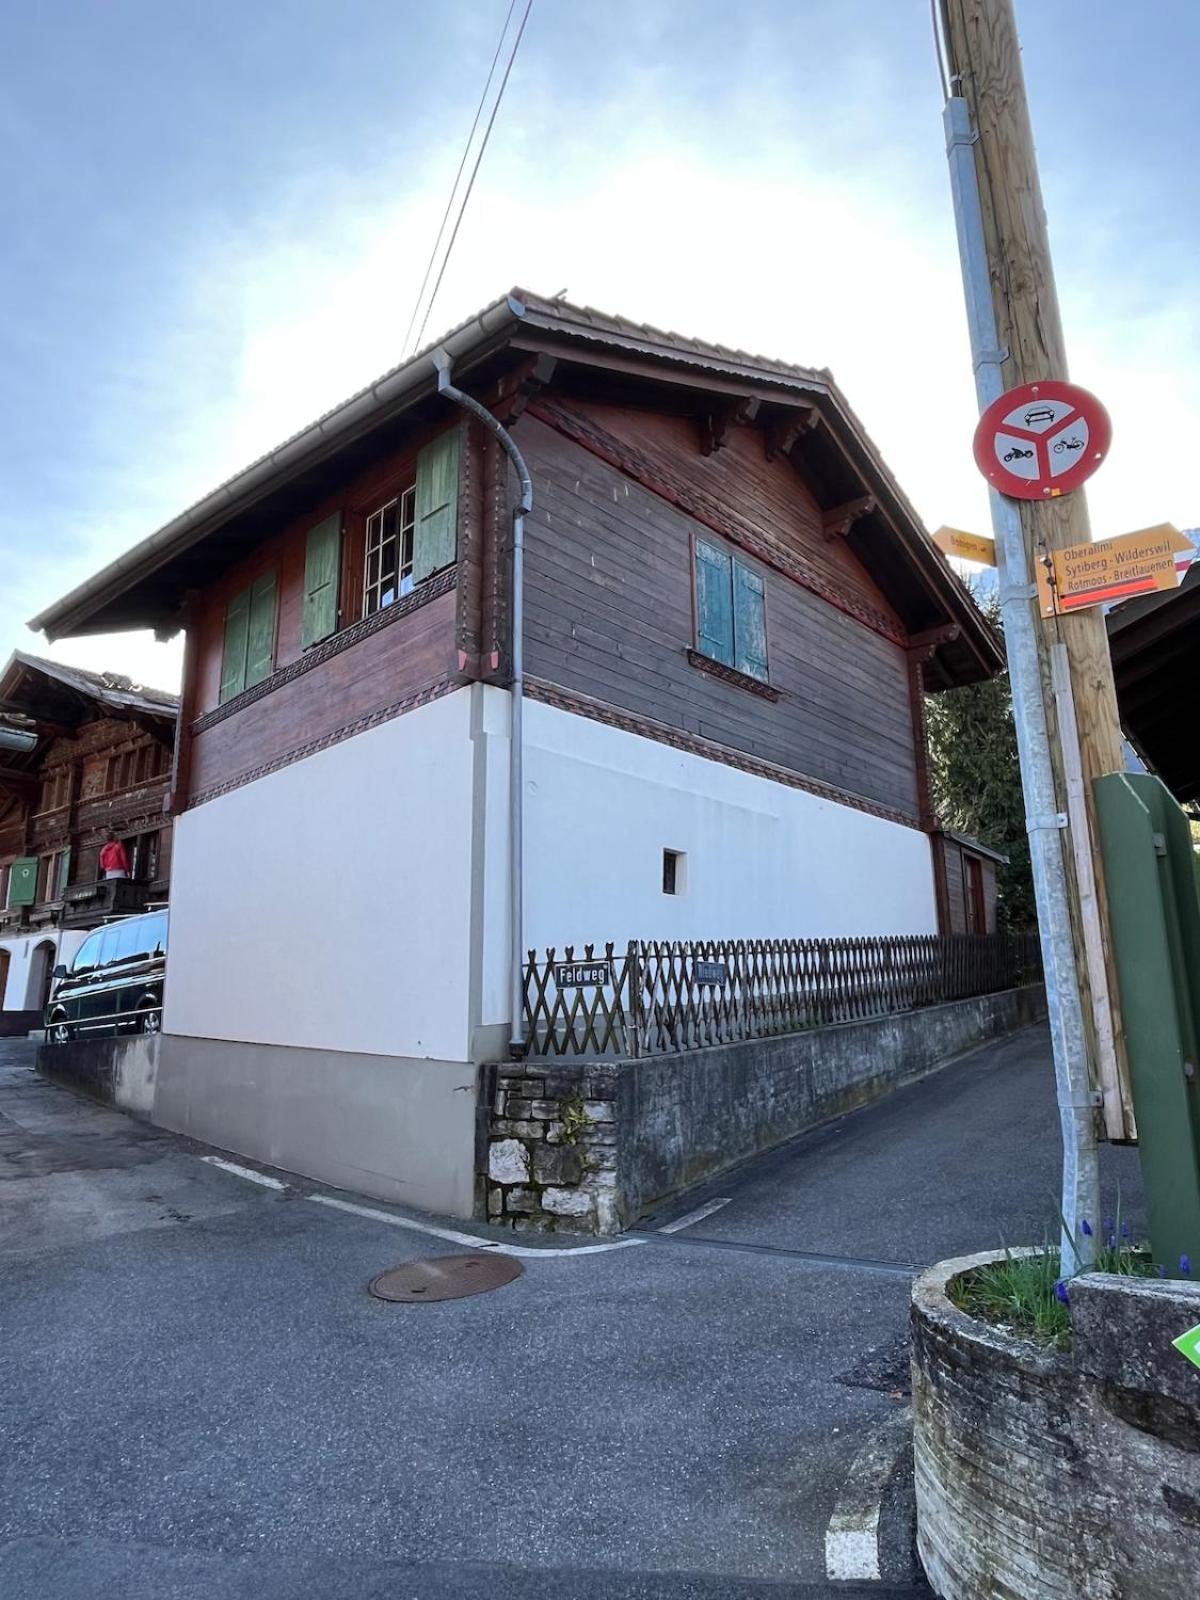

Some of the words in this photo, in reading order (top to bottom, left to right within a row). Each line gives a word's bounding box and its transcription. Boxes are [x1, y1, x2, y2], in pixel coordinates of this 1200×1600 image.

[1065, 558, 1108, 577] Sytiberg
[1114, 540, 1171, 564] Wilderswil
[1068, 575, 1108, 591] Rotmoos
[1114, 559, 1174, 580] Breitlauenen
[560, 966, 605, 984] Feldweg
